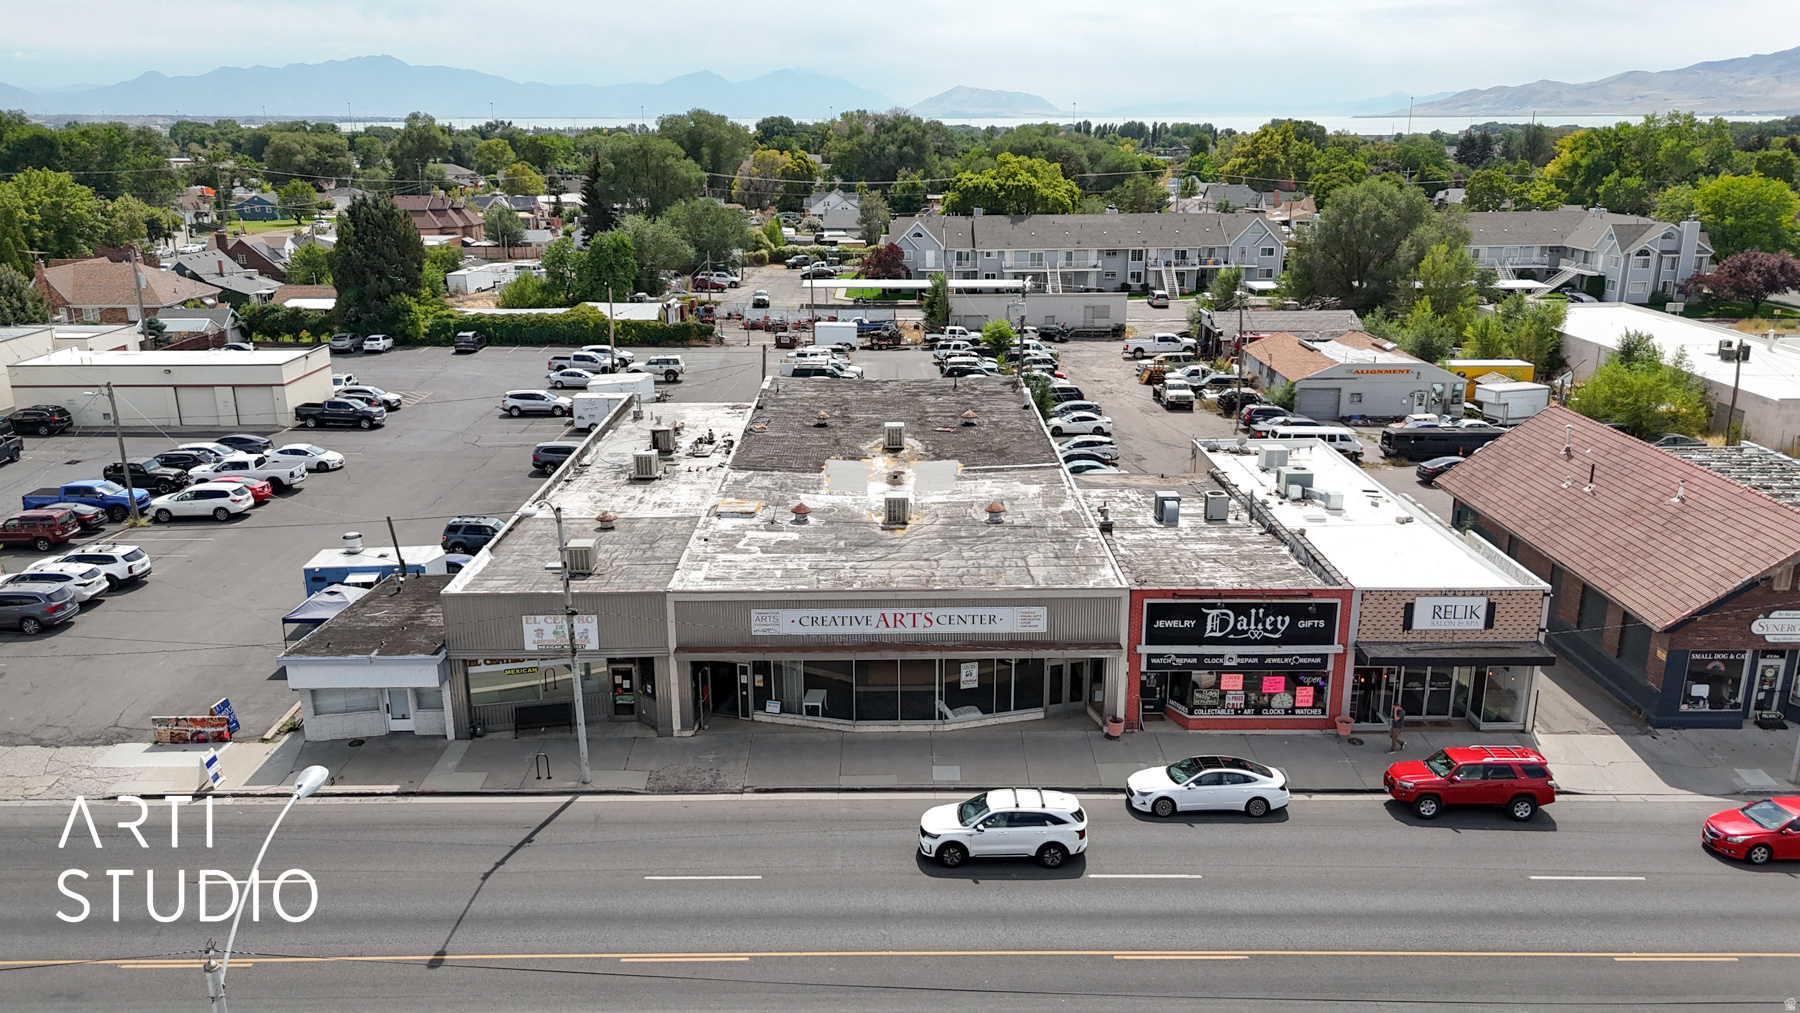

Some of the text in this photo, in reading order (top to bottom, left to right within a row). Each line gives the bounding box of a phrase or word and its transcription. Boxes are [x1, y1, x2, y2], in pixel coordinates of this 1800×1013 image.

[1432, 604, 1482, 620] RELIK
[525, 616, 594, 625] EL CENRO
[798, 611, 998, 629] CREATIVE ARTS CENTER
[1153, 619, 1196, 628] JEWELRY
[1201, 607, 1291, 638] Dalley
[1297, 619, 1325, 628] GIFTS
[1264, 657, 1292, 665] JEWELRY
[504, 667, 538, 675] MEXICAN
[1169, 699, 1189, 714] ANTIQUES
